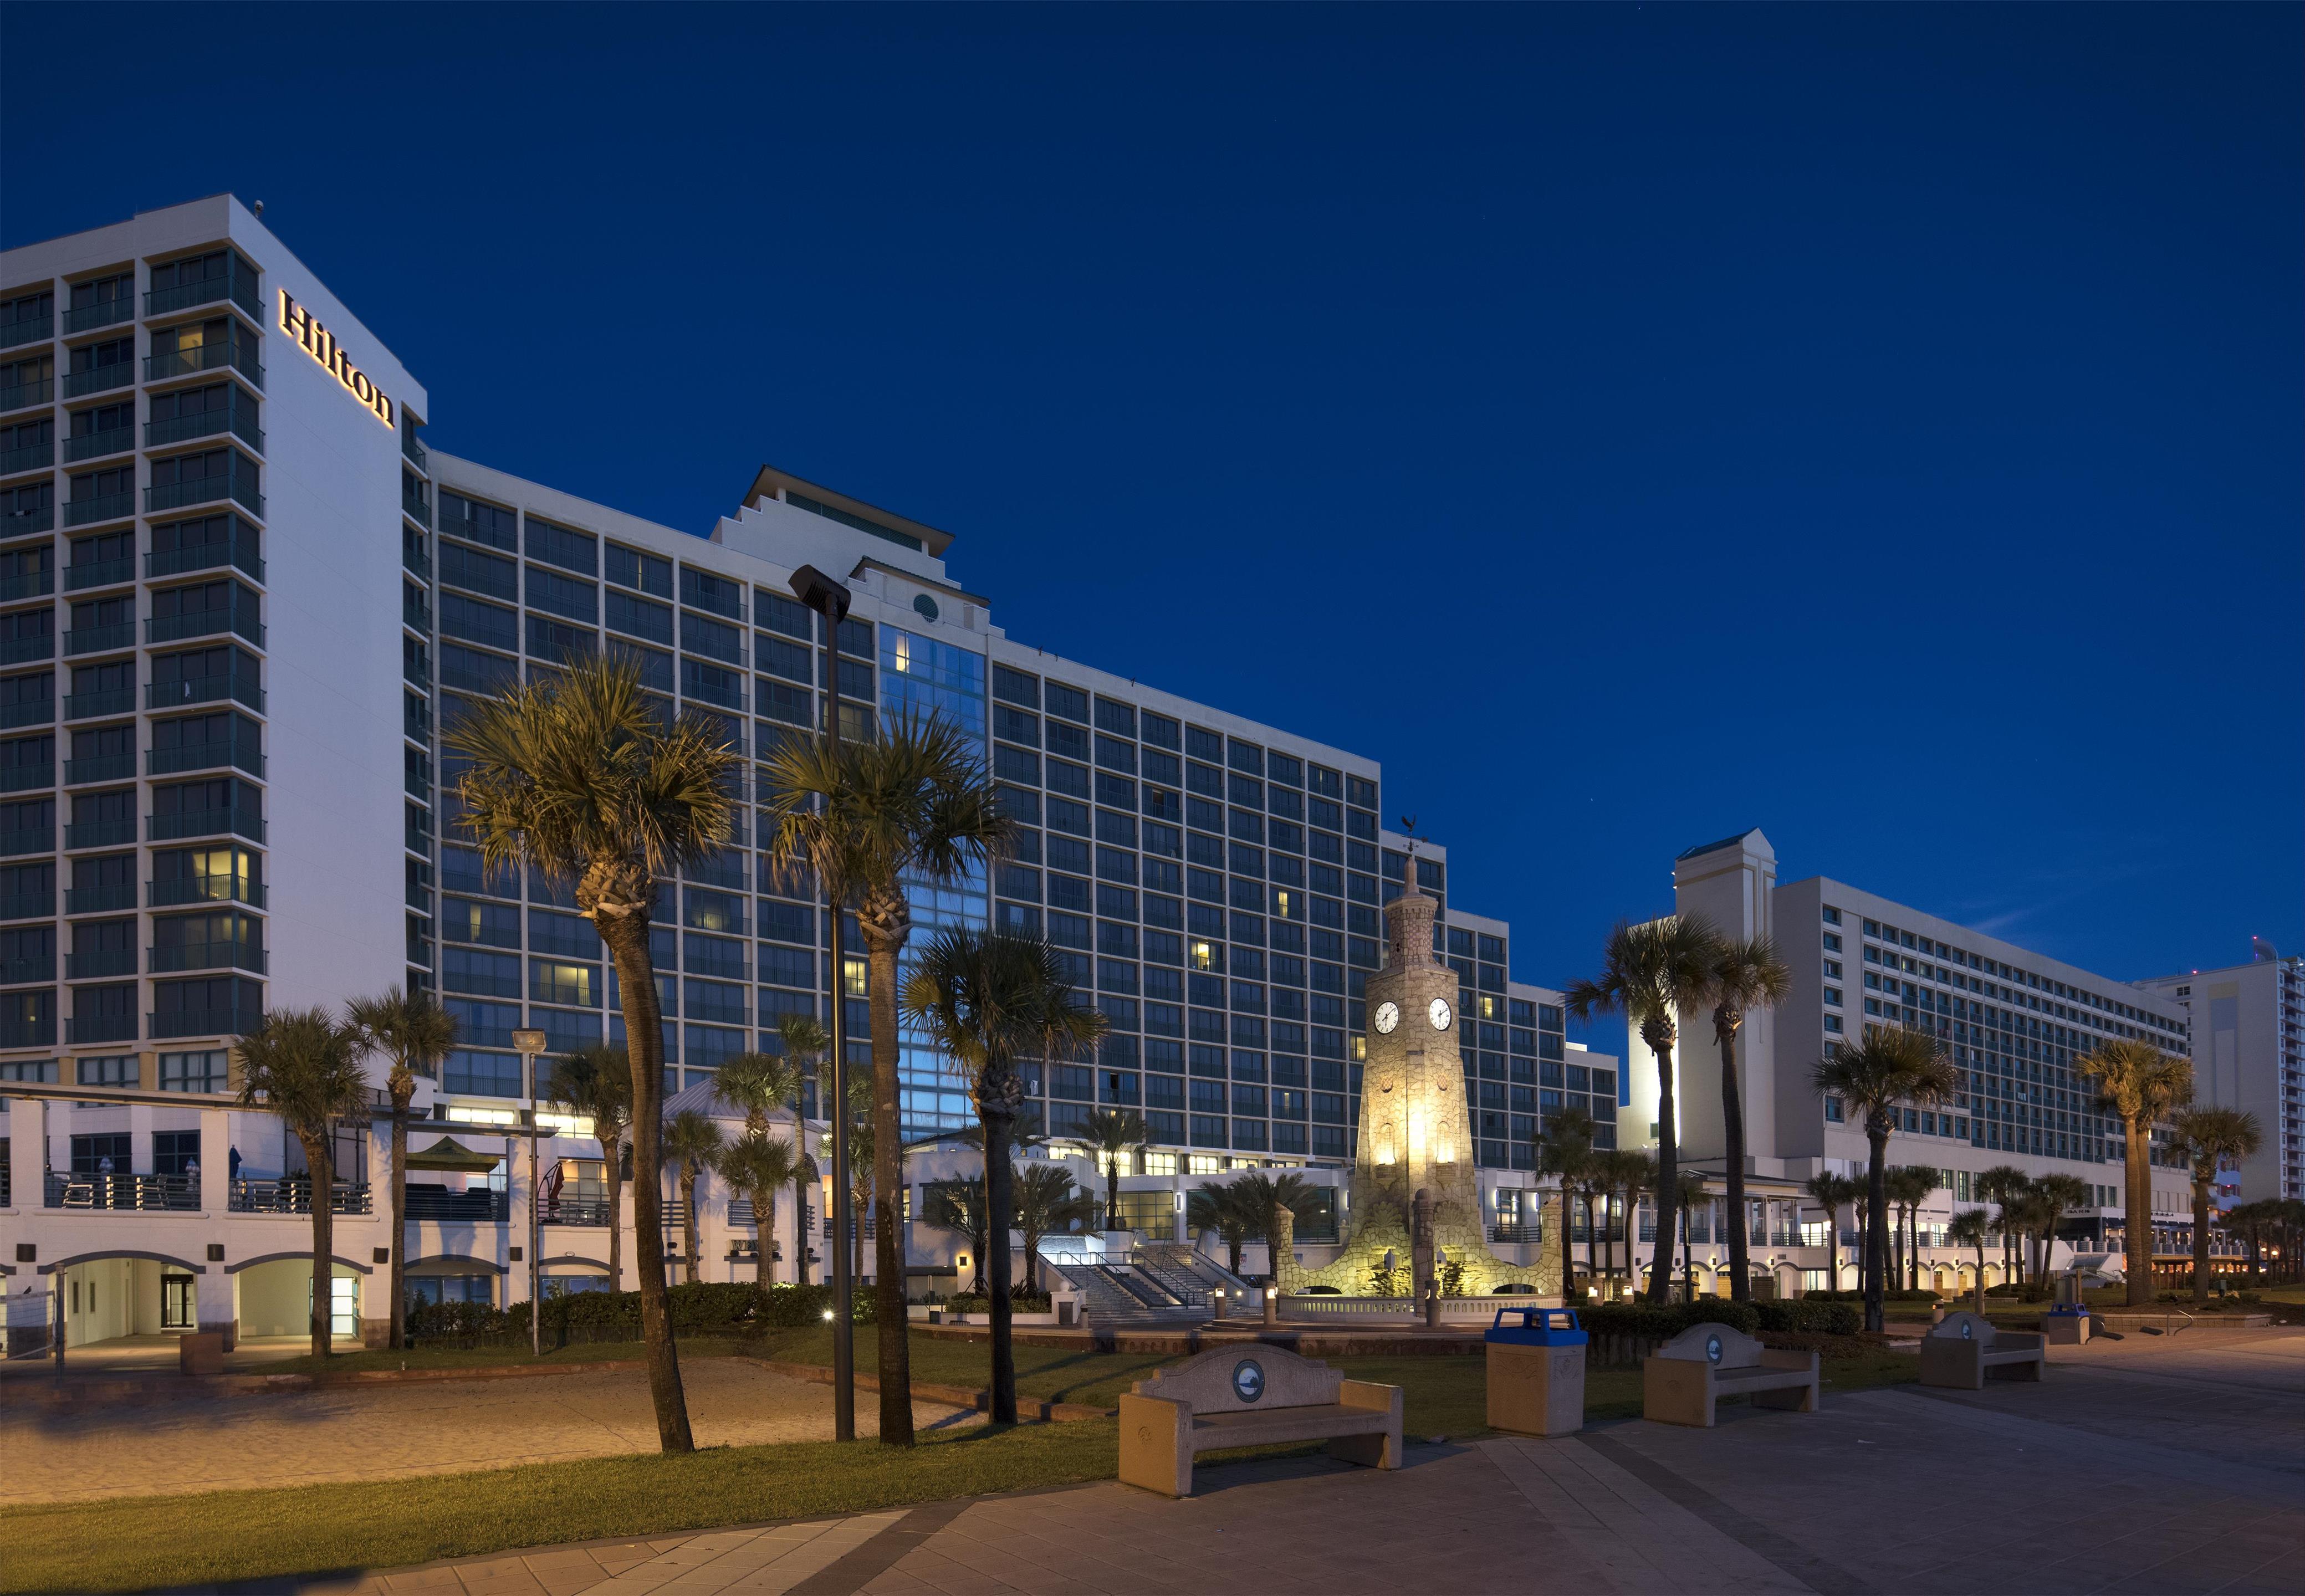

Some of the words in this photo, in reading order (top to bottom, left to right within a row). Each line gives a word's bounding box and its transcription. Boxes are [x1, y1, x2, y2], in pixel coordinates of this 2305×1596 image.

[280, 289, 395, 428] Hilton
[1376, 1003, 1398, 1022] DAYTONA
[1377, 1020, 1397, 1032] BEACH
